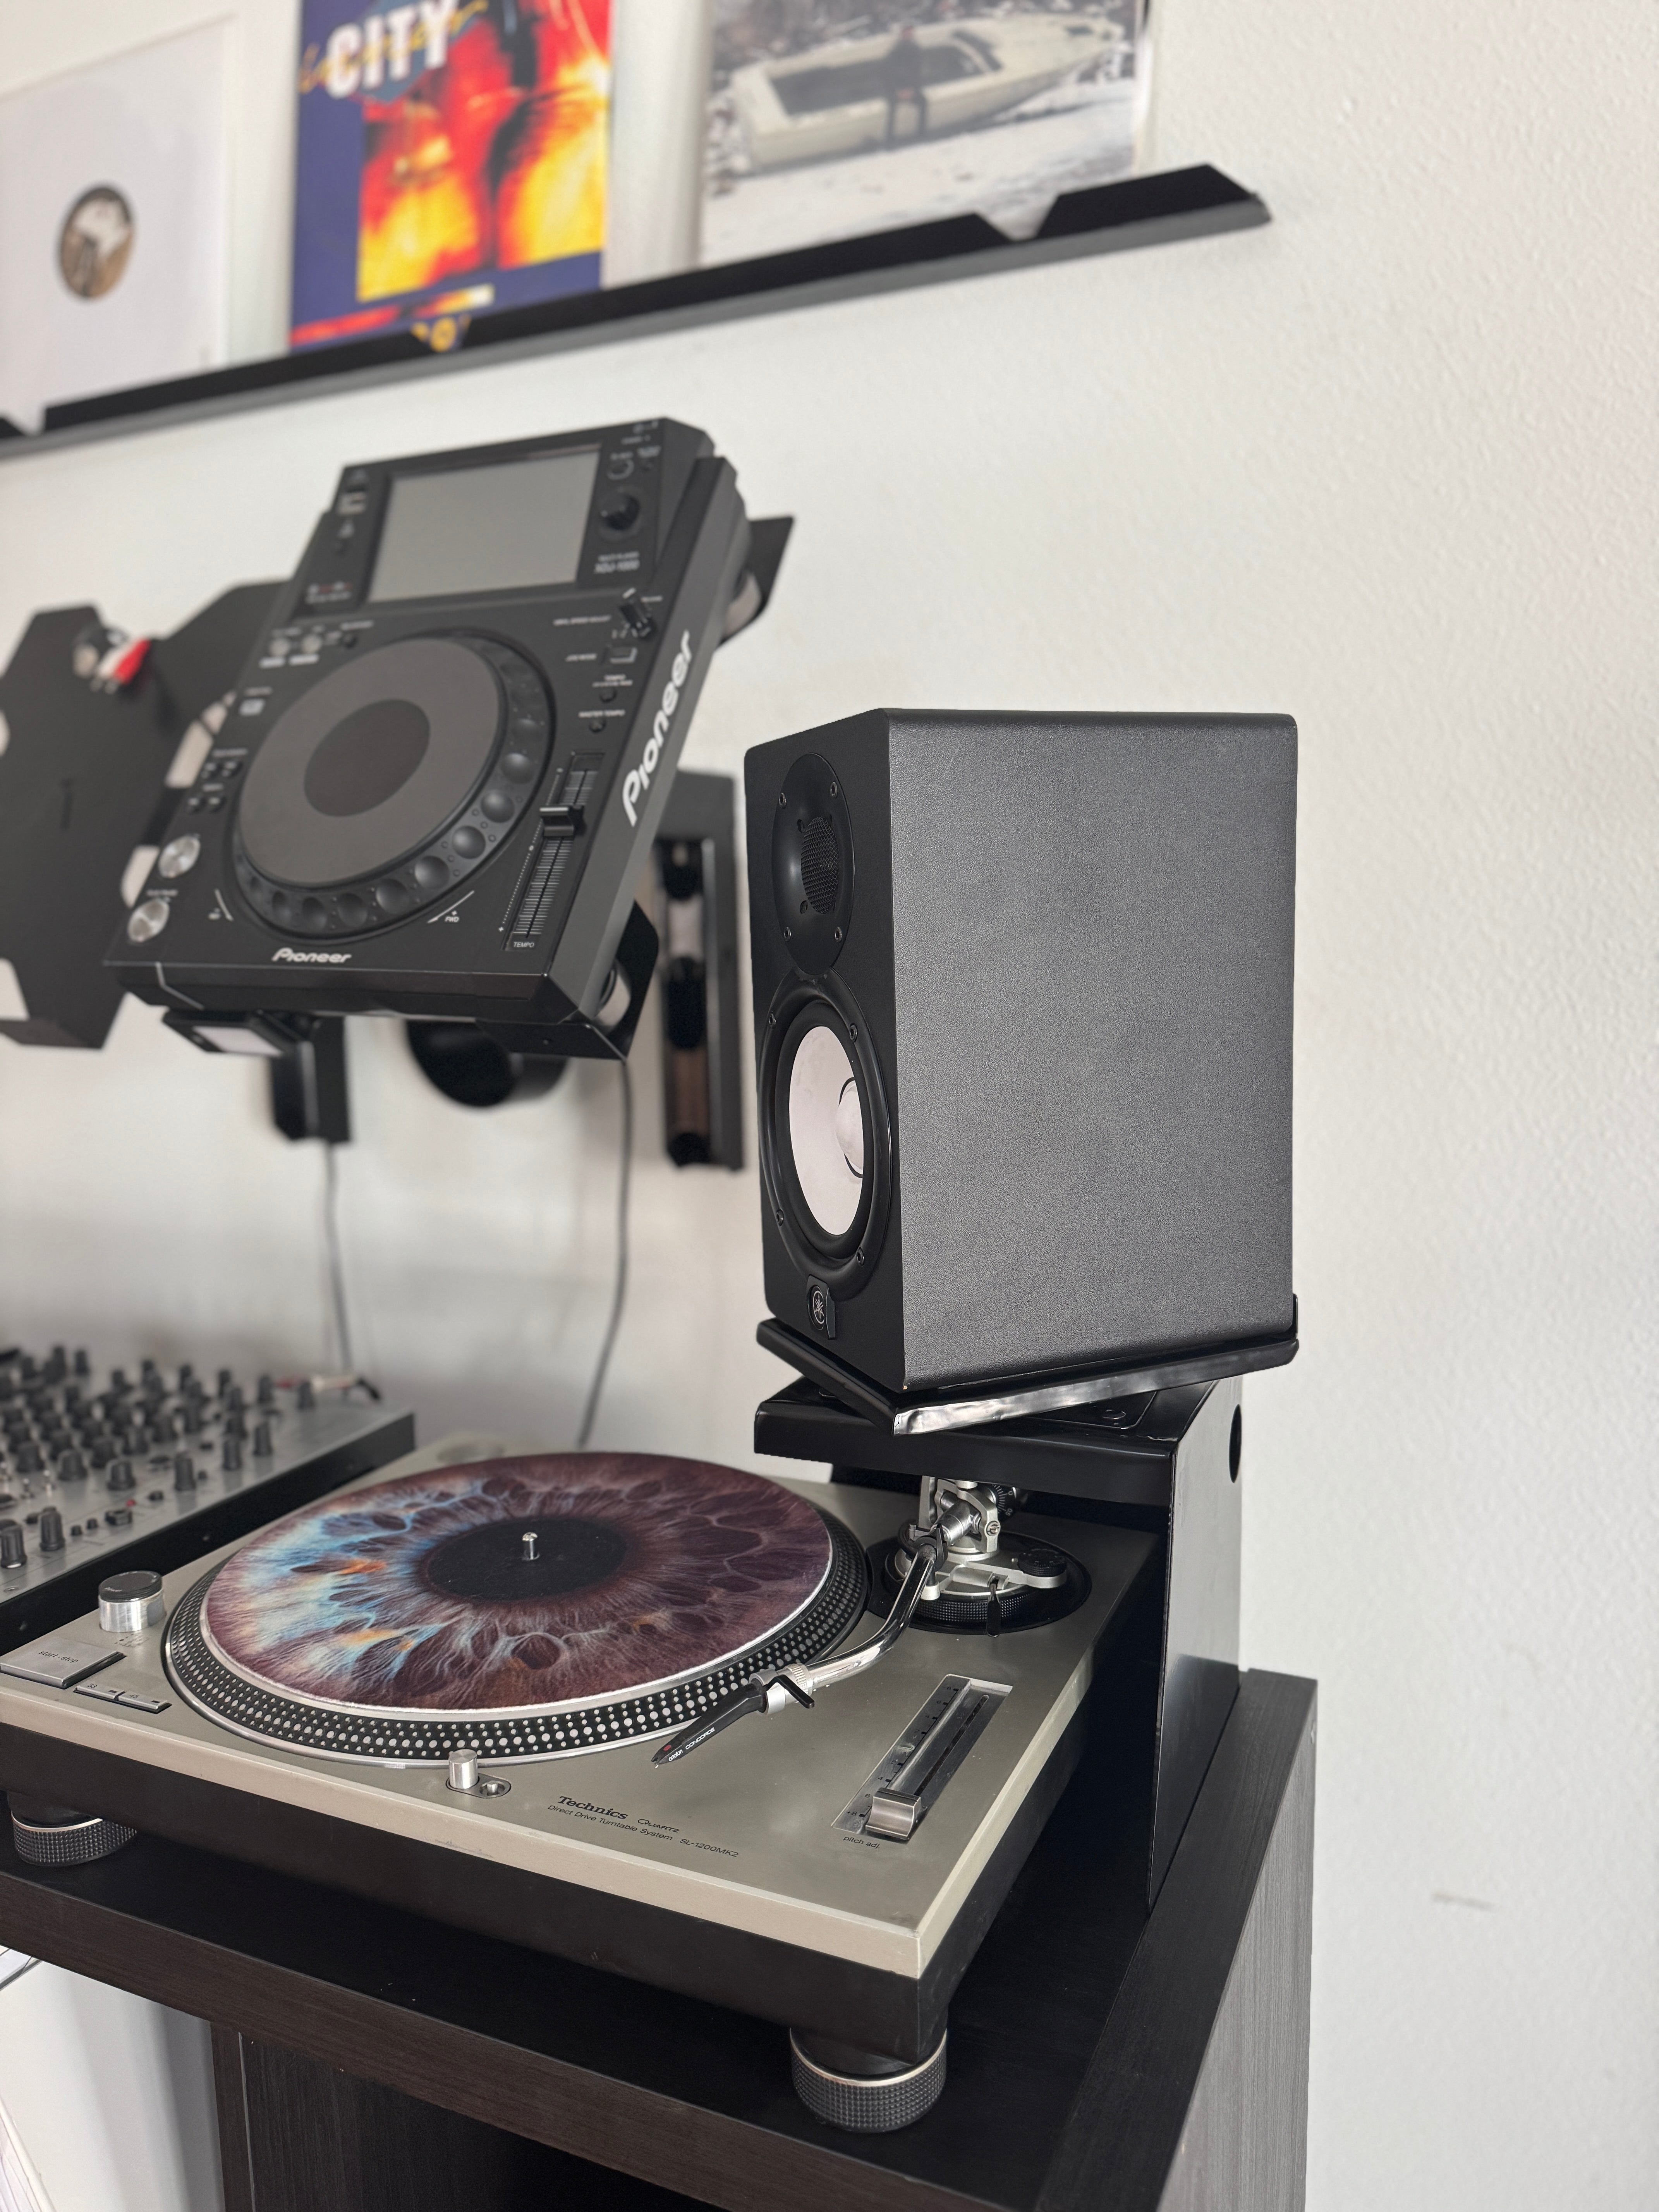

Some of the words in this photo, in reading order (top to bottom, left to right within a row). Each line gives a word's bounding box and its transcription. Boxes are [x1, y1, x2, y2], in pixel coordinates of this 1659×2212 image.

[325, 0, 459, 98] CITY
[623, 630, 692, 827] Pioneer
[272, 948, 352, 963] Pioneer
[668, 1749, 683, 1762] ortofon
[685, 1727, 715, 1750] CONCORDE
[558, 1796, 628, 1819] Technics
[548, 1805, 573, 1815] Direct
[574, 1812, 597, 1821] Drive
[599, 1818, 638, 1832] Turntable
[640, 1829, 673, 1841] System
[680, 1839, 739, 1857] SL-1200MK2
[843, 1836, 864, 1844] pitch
